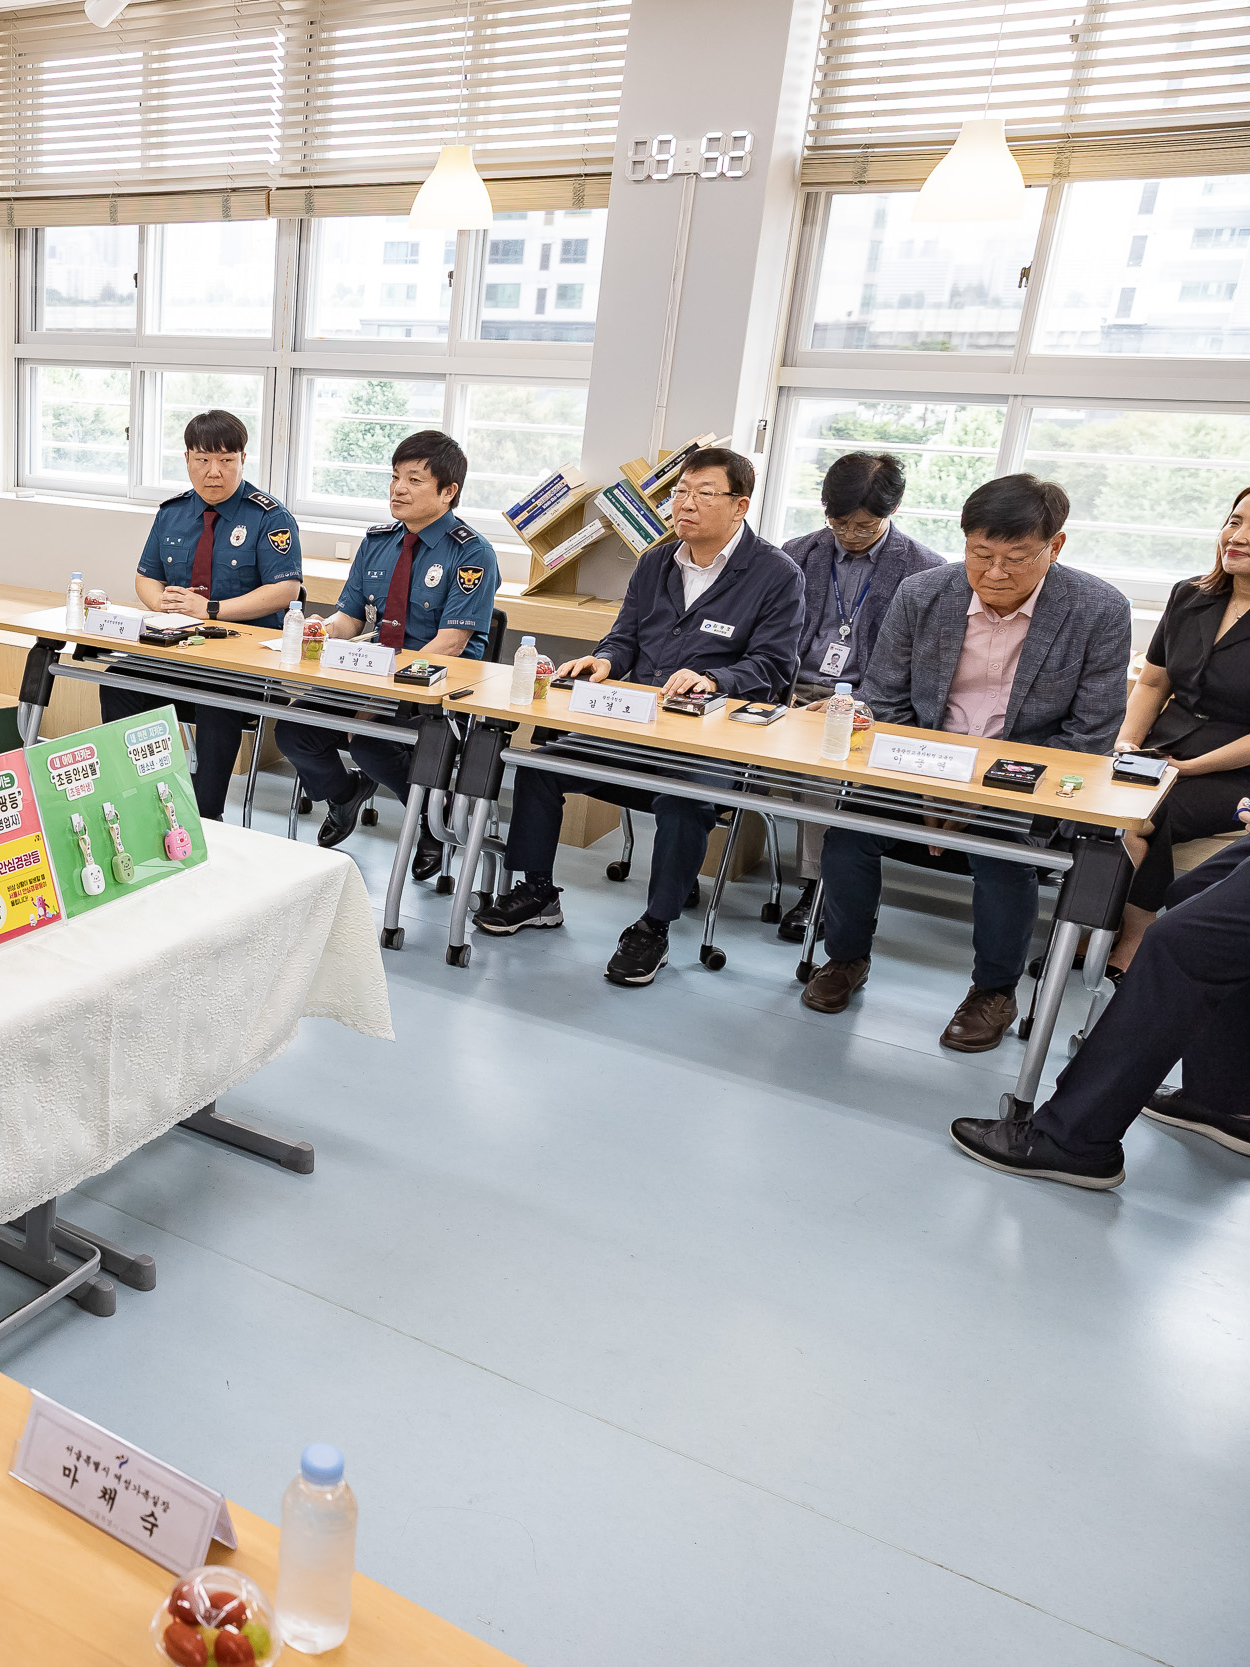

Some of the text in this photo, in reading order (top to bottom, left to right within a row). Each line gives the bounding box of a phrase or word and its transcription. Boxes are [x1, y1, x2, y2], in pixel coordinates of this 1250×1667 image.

[63, 1464, 79, 1490] 마
[97, 1485, 117, 1513] 채
[139, 1510, 159, 1538] 숙
